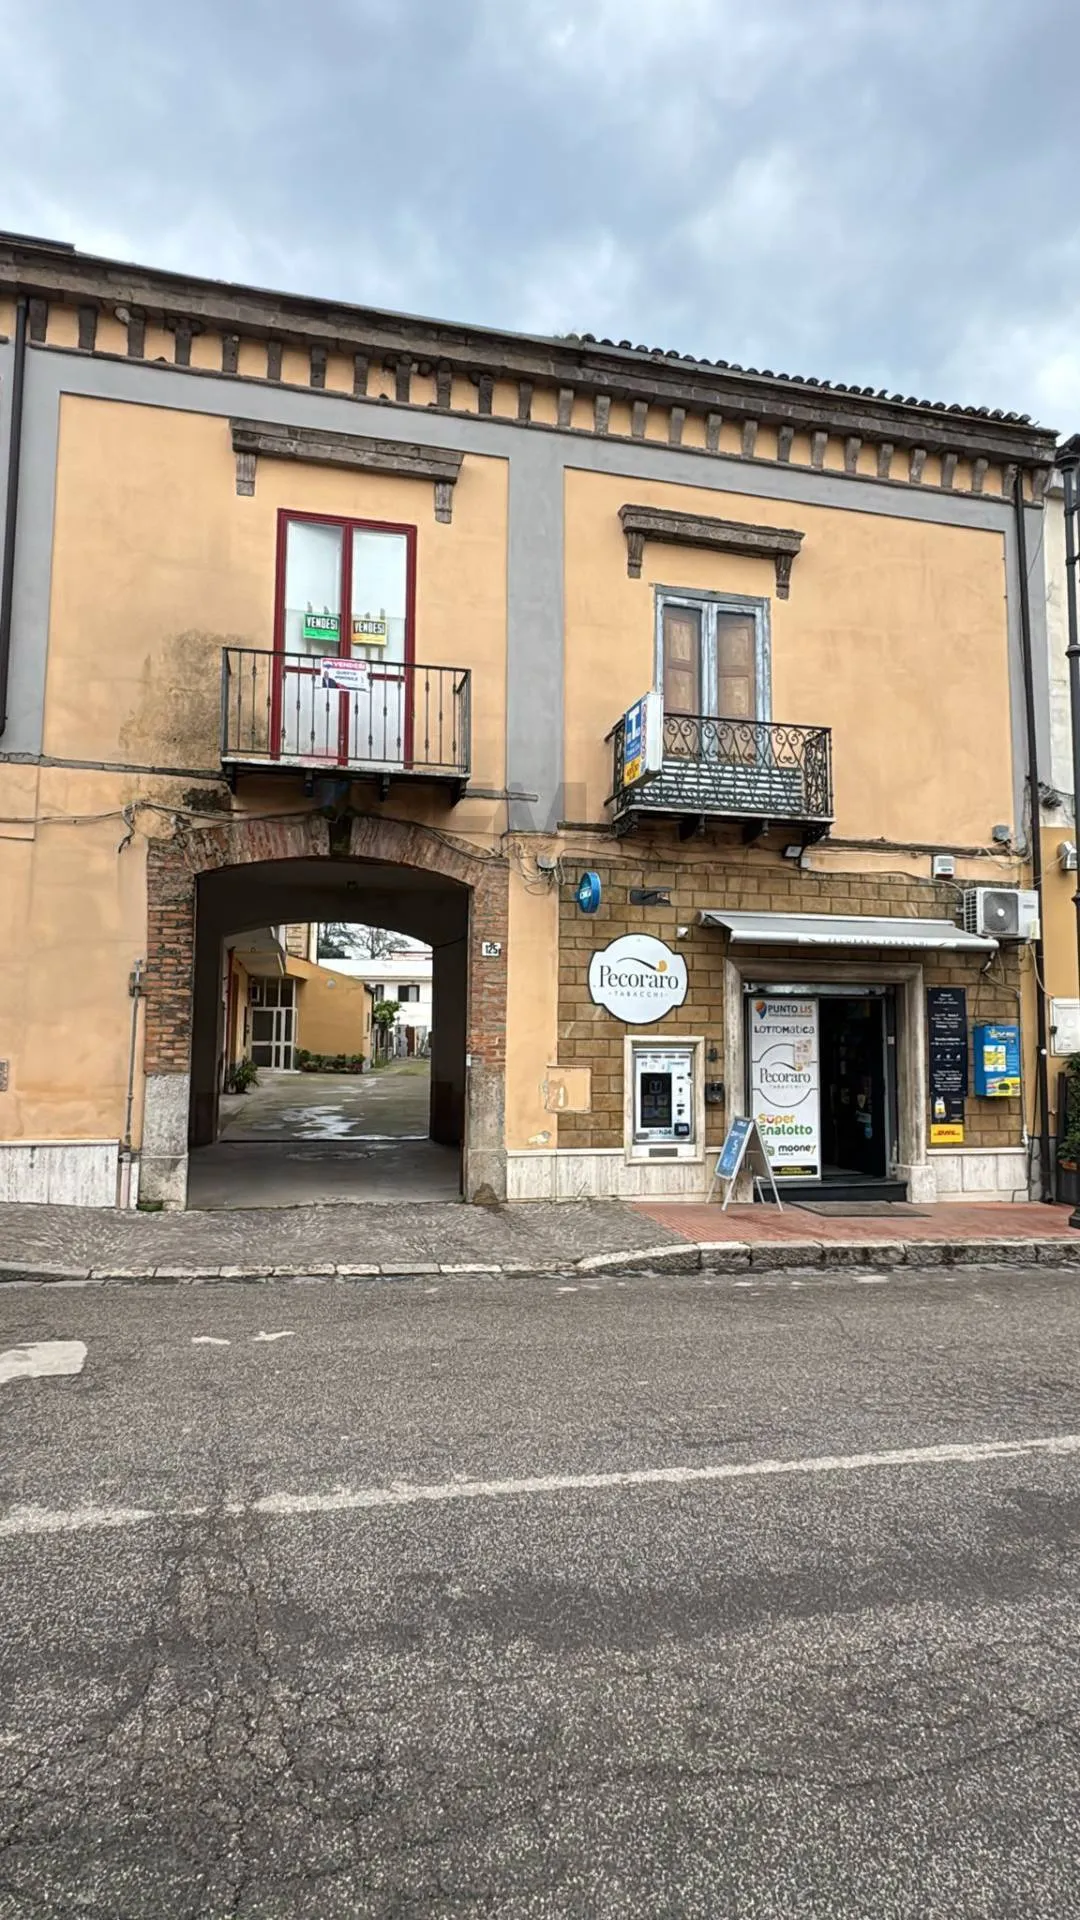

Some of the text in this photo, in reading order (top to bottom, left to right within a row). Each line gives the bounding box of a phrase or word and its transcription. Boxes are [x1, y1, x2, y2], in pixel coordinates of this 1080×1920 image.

[306, 616, 338, 630] VENDESI
[355, 621, 385, 633] VENDESI
[485, 944, 498, 954] 125
[599, 965, 679, 989] Pecoraro
[768, 1004, 812, 1013] PUNTO LIS
[760, 1068, 811, 1083] Pecoraro
[758, 1113, 795, 1125] Super
[759, 1124, 813, 1135] Enalotto
[778, 1144, 816, 1154] mooney
